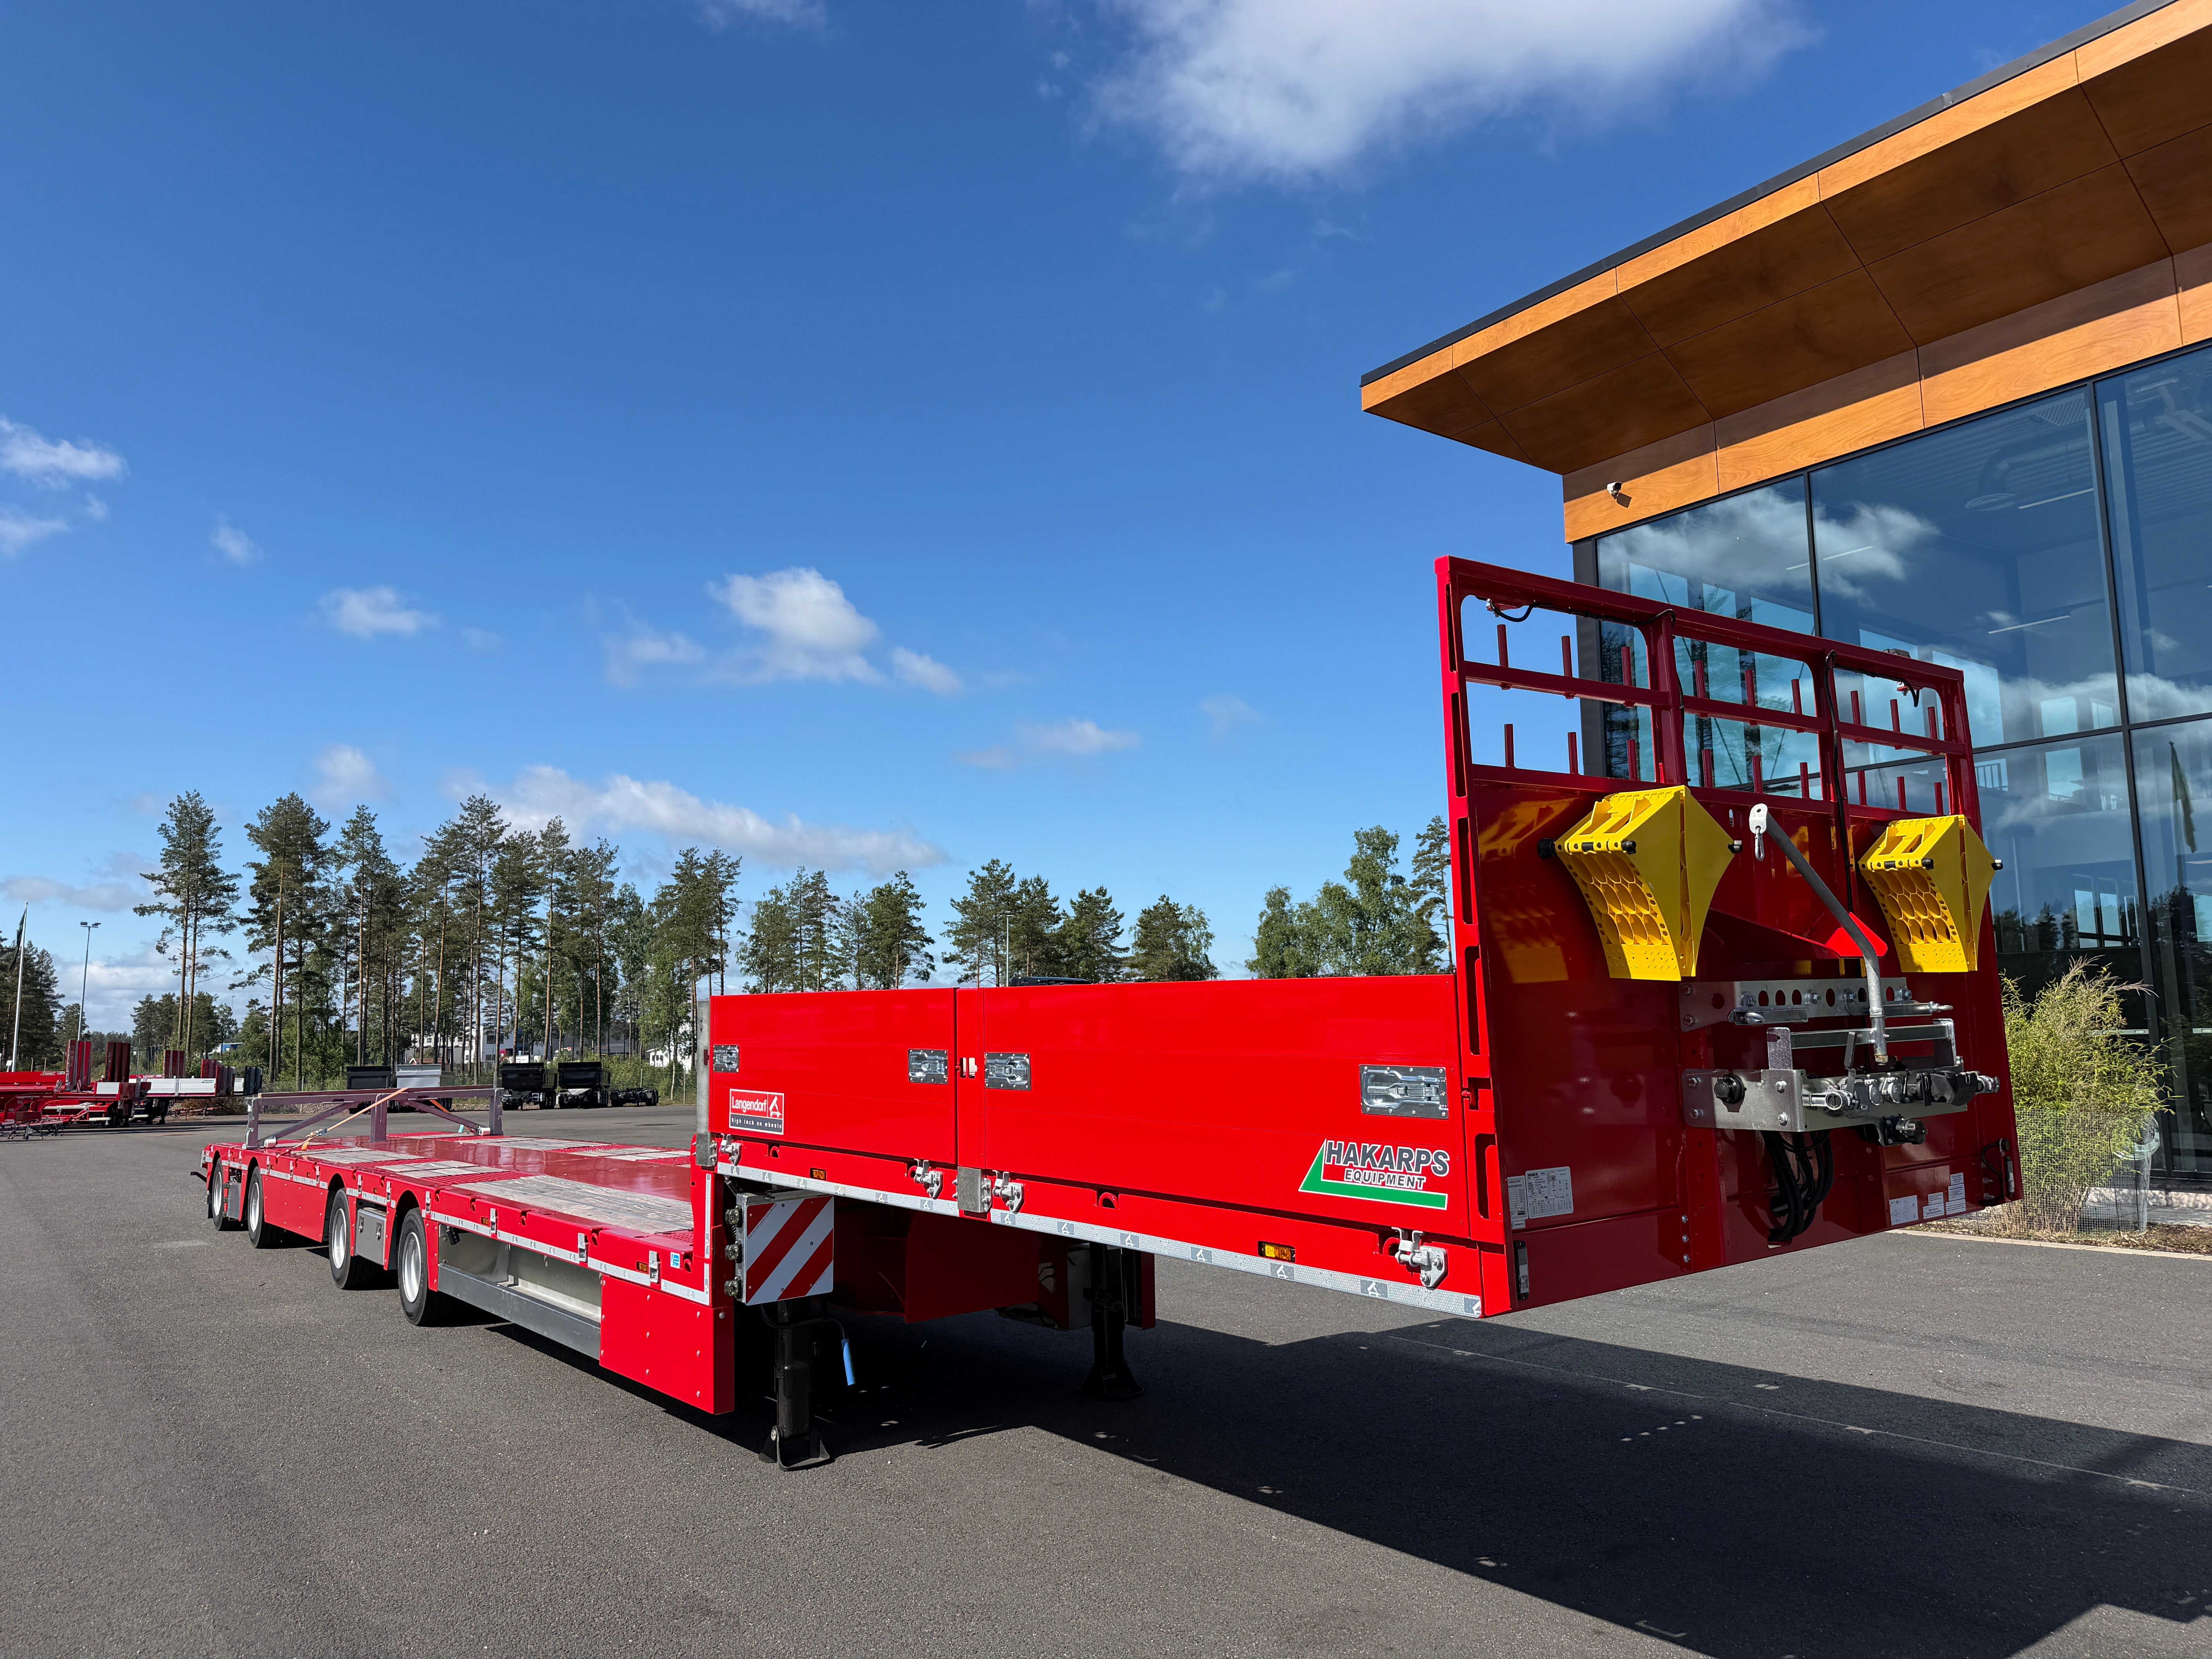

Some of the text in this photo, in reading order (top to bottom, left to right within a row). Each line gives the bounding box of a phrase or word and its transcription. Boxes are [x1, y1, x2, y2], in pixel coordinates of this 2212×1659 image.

[732, 1096, 767, 1113] Langendorf
[1325, 1140, 1449, 1176] HAKARPS
[1344, 1168, 1426, 1190] EQUIPMENT
